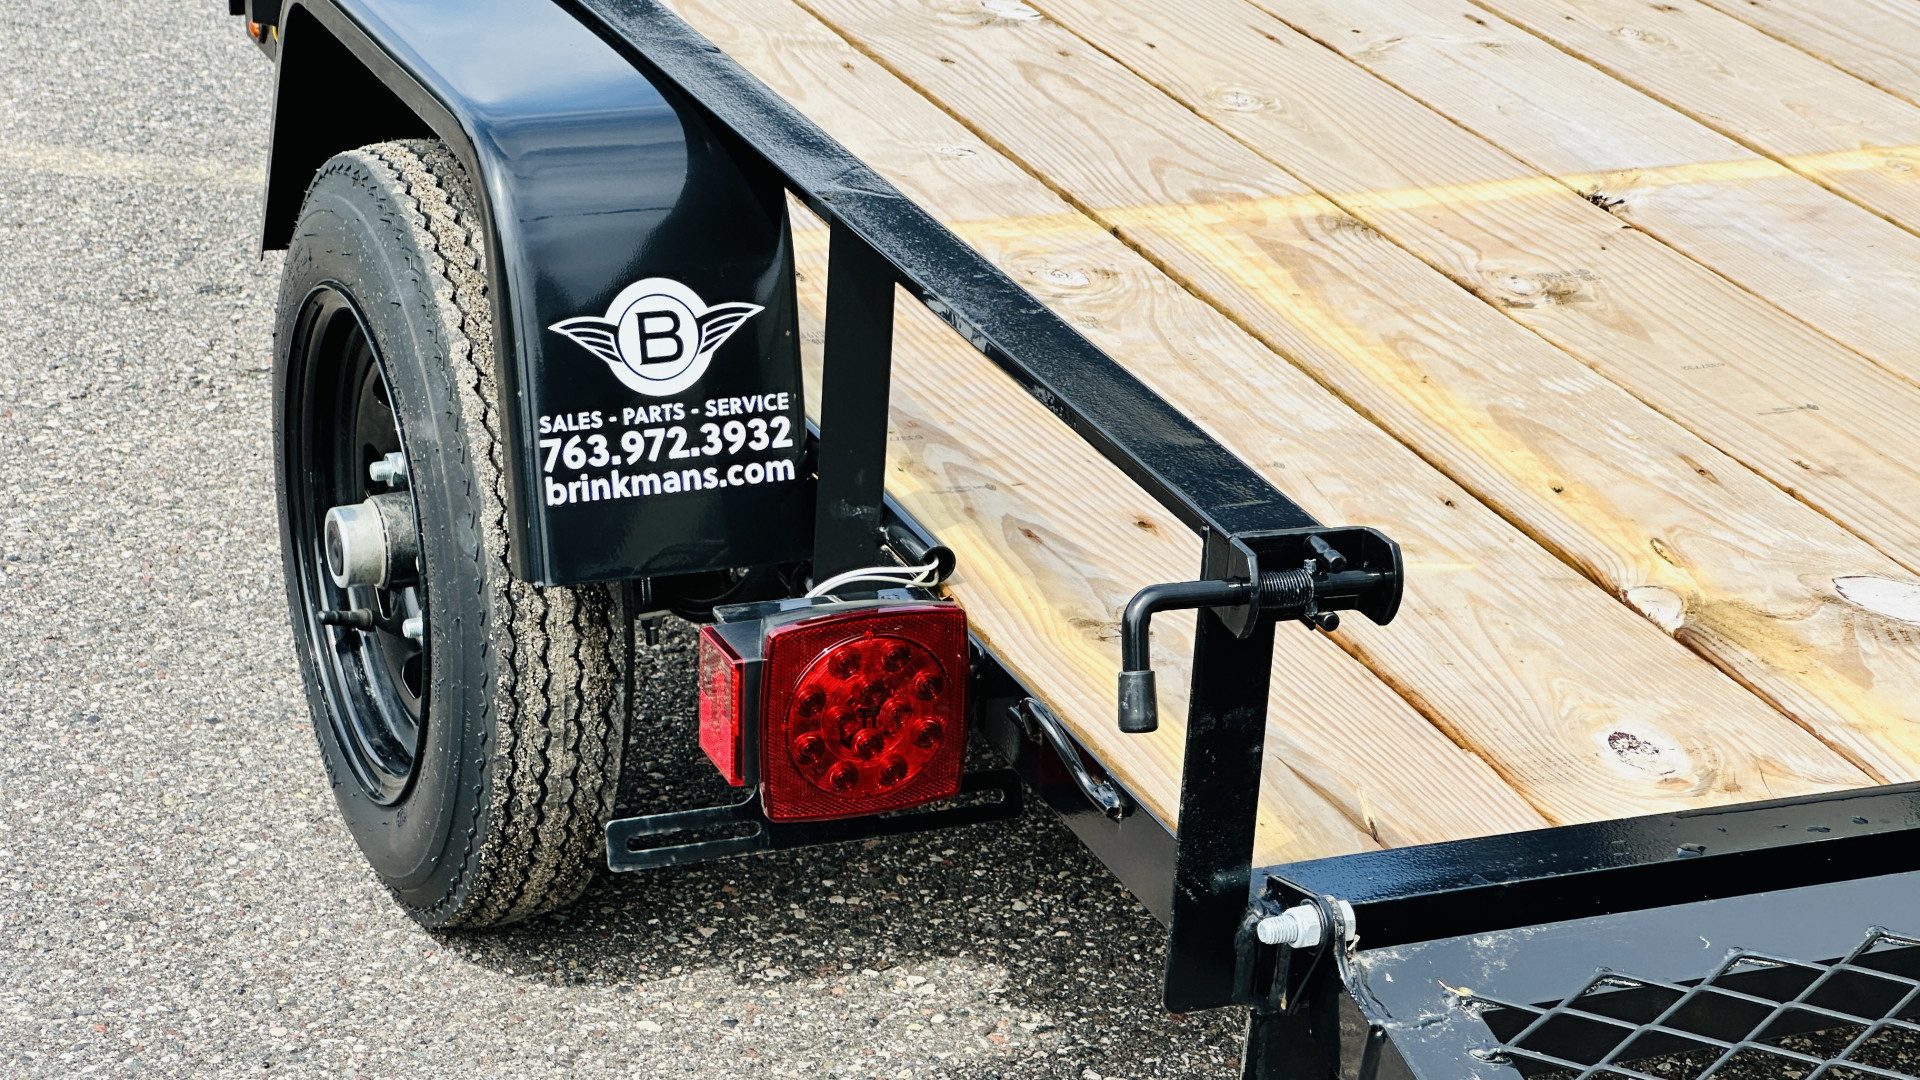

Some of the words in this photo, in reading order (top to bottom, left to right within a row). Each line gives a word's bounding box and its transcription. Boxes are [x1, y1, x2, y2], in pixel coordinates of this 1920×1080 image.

[635, 309, 684, 366] B
[538, 410, 604, 434] SALES
[622, 402, 686, 426] PARTS
[704, 391, 790, 418] SERVICE
[538, 415, 794, 473] 763.972.3932
[544, 458, 796, 507] brinkmans.com
